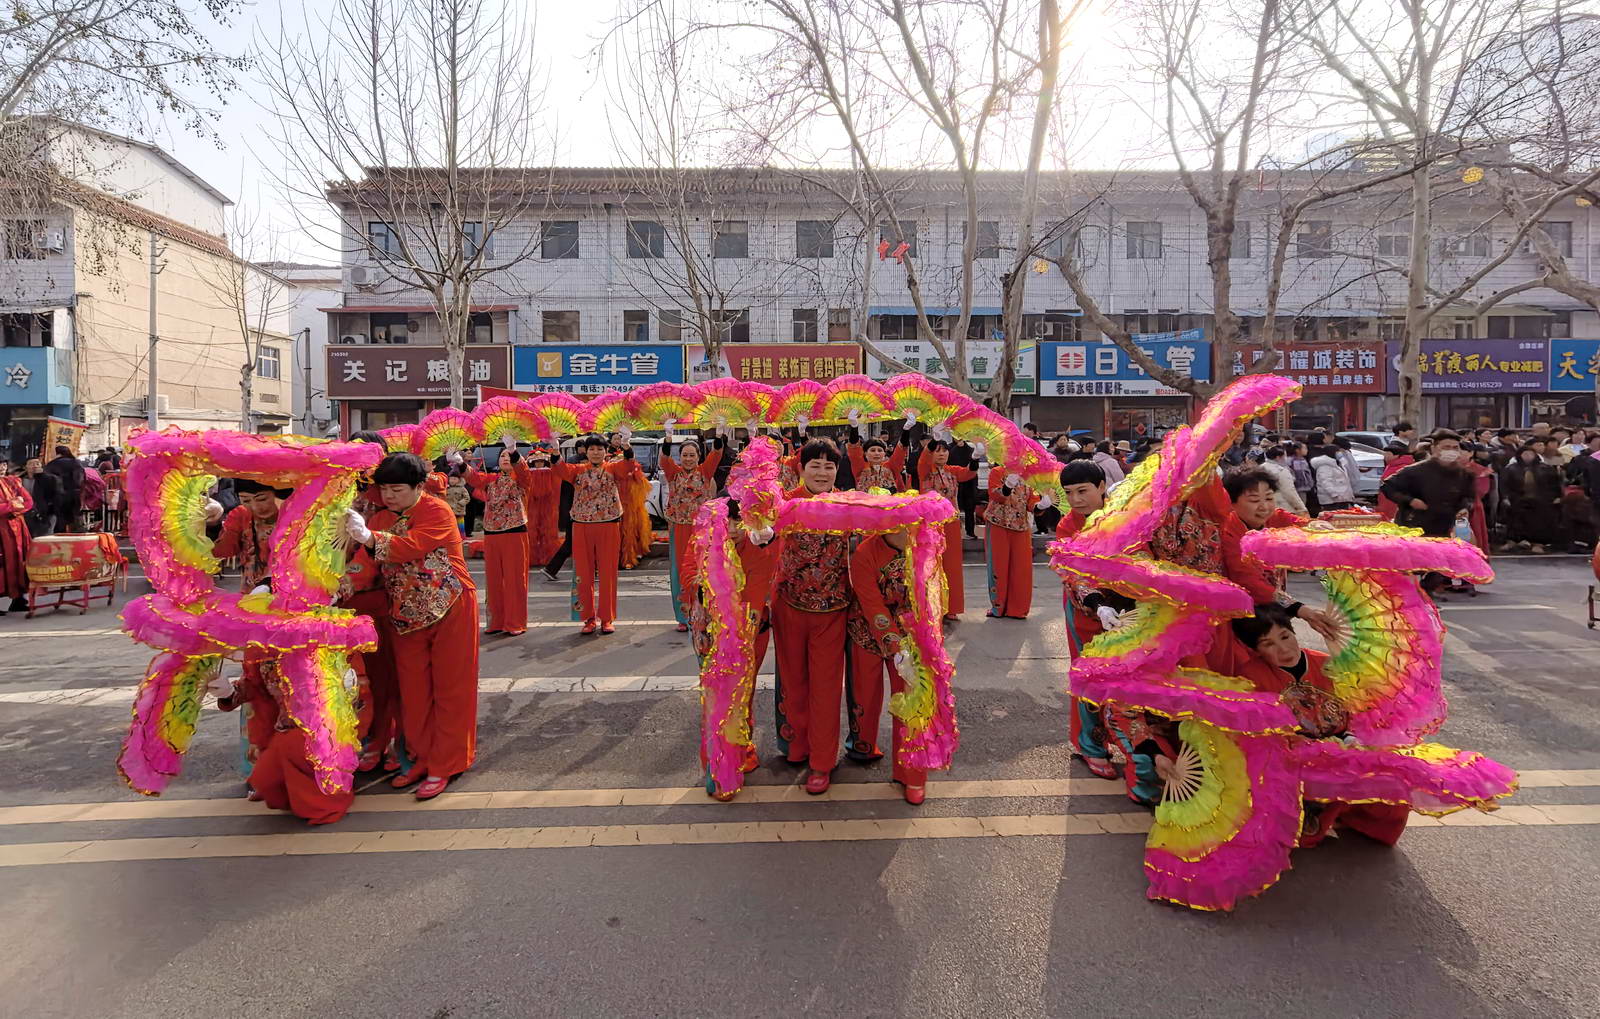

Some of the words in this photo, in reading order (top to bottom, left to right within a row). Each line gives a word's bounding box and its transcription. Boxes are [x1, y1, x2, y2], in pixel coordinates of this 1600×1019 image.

[4, 362, 32, 389] 冷
[343, 359, 491, 382] 关记粮油
[569, 352, 660, 376] 金牛管
[740, 357, 773, 380] 背景墙
[778, 357, 810, 379] 装饰画
[879, 355, 988, 375] 塑家管
[1332, 373, 1374, 386] 品牌墙布
